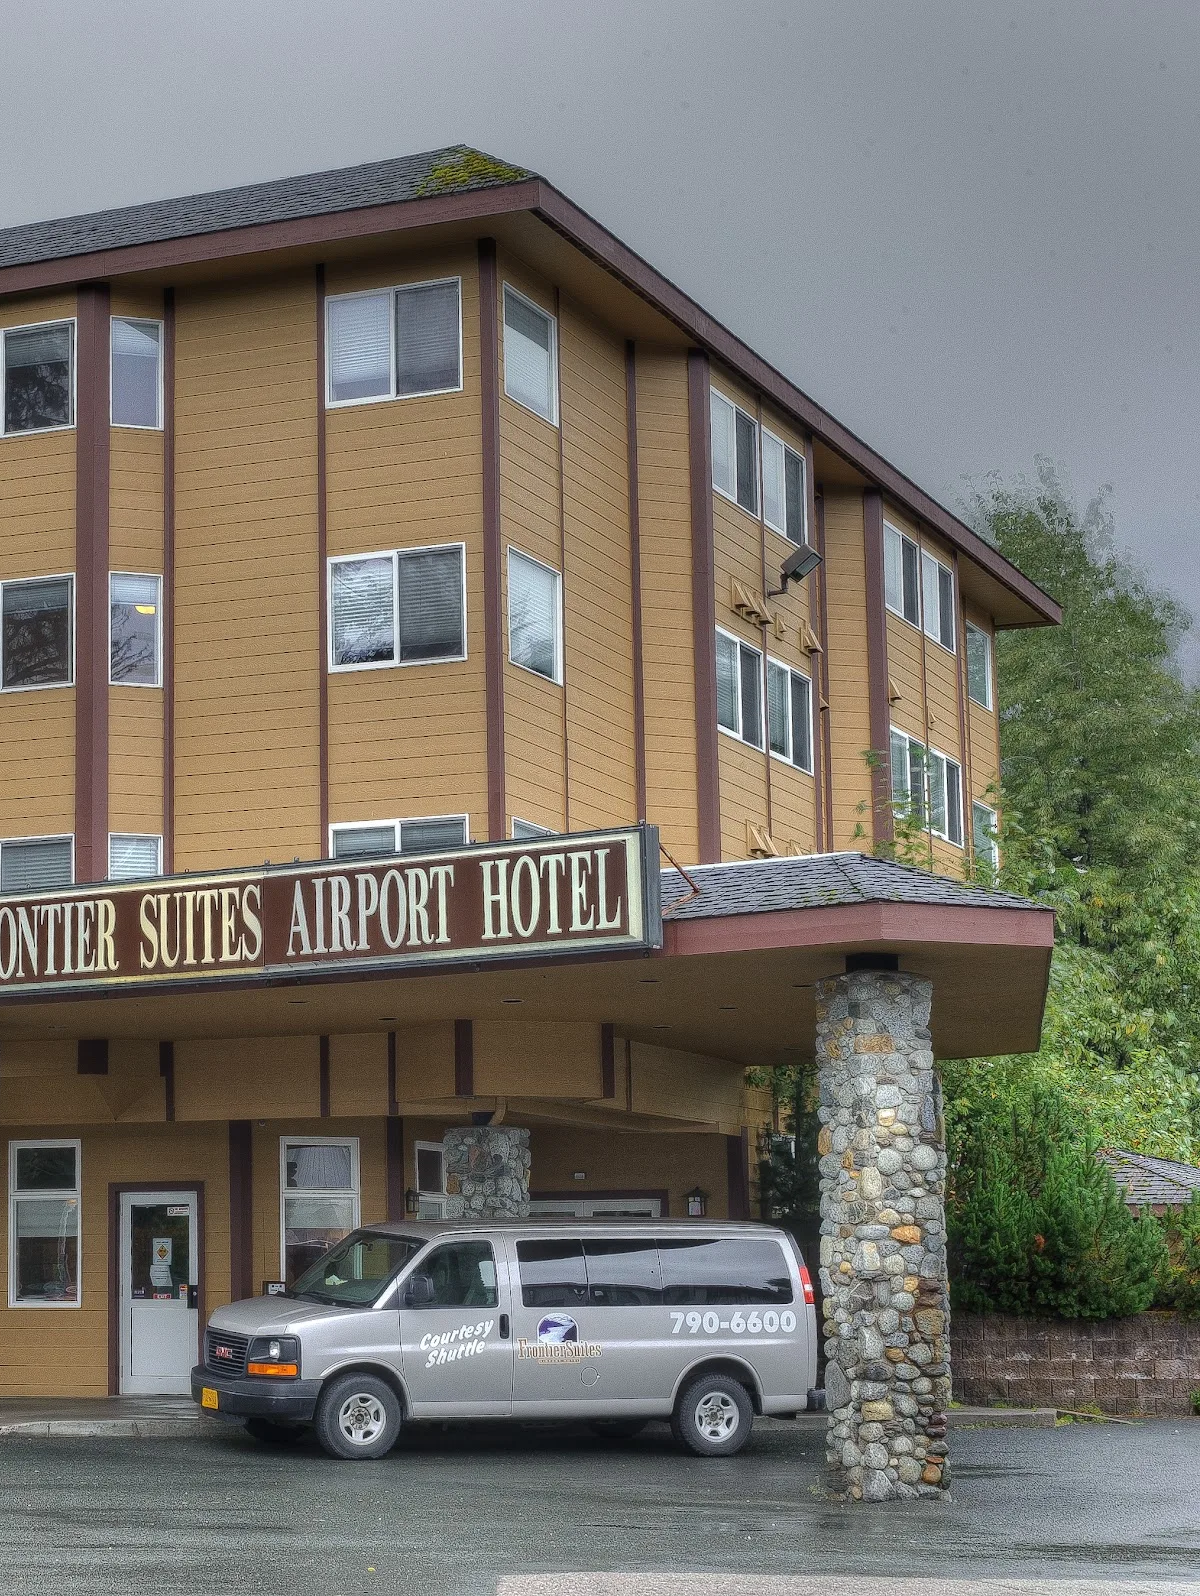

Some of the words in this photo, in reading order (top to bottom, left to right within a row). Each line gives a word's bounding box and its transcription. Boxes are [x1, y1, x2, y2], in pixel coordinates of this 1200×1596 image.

[140, 884, 263, 968] SUITES
[286, 865, 455, 957] AIRPORT
[479, 849, 623, 940] HOTEL
[419, 1319, 494, 1351] Courtesy
[670, 1310, 797, 1334] 790-6600
[424, 1338, 486, 1369] Shuttle
